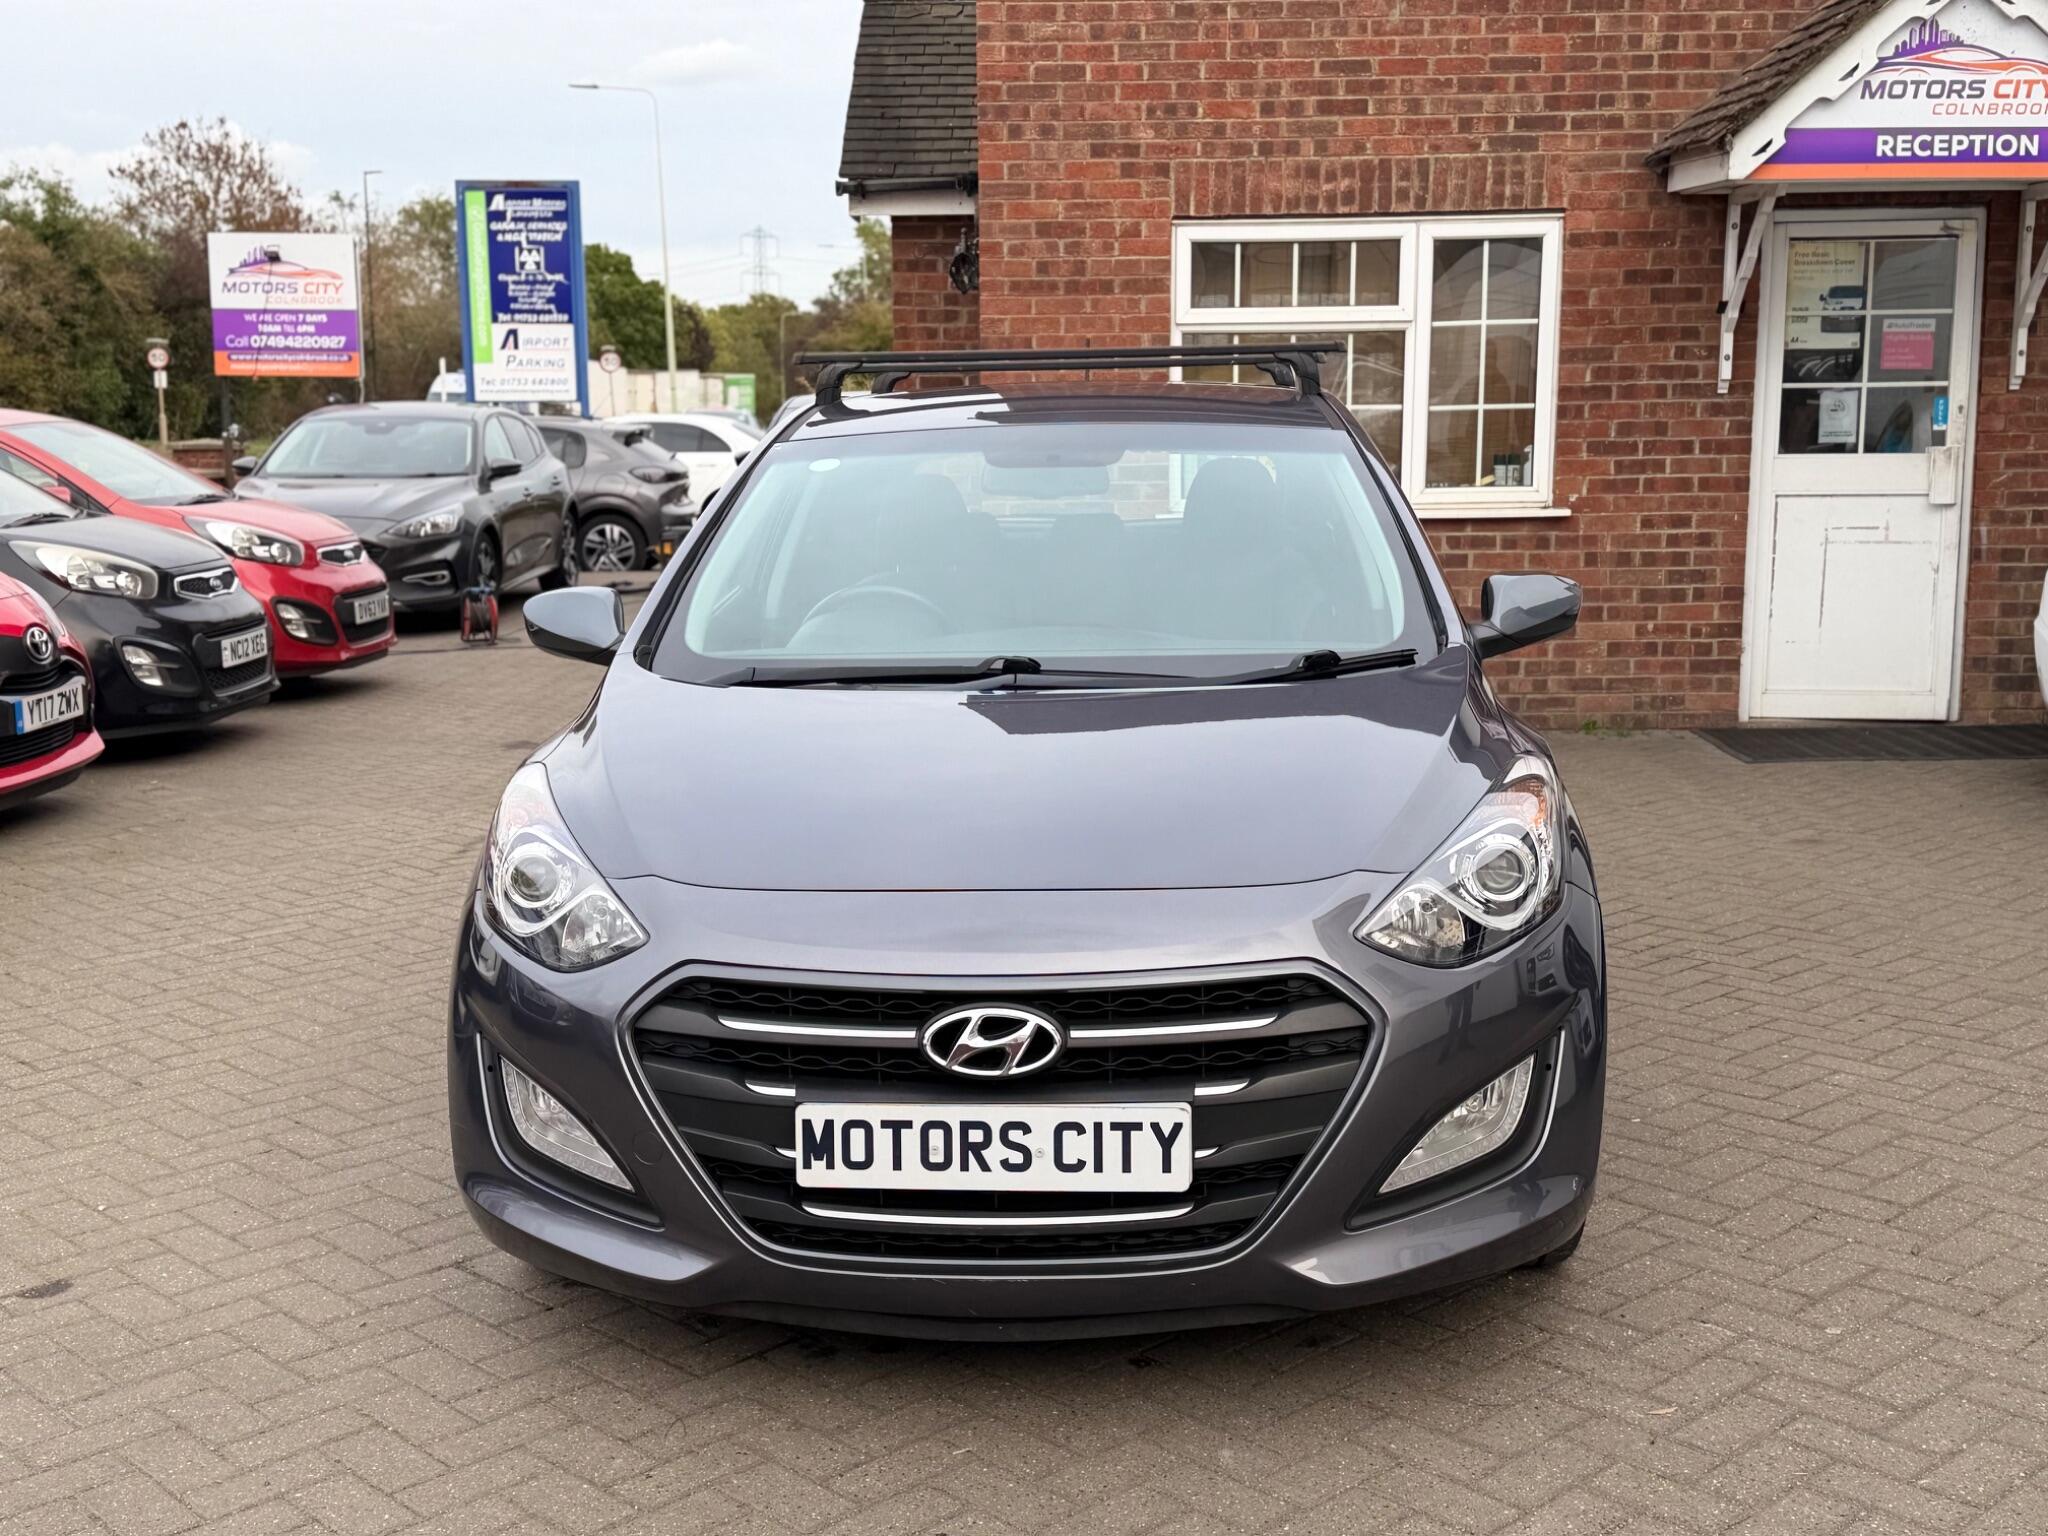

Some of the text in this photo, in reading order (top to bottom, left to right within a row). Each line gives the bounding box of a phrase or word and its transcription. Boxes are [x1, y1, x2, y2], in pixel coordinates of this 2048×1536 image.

[1860, 79, 1987, 99] MOTORS
[1932, 103, 2048, 115] COLNBROO
[1876, 134, 2039, 157] RECEPTION
[222, 281, 344, 295] MOTORS CITY
[243, 313, 257, 322] WE
[274, 313, 297, 322] OPEN
[305, 313, 328, 323] DAYS
[225, 334, 249, 348] Call
[501, 328, 570, 351] AIRPORT
[506, 354, 566, 369] PARKING
[230, 633, 265, 661] NC12 XEG
[27, 687, 80, 725] YT17 ZWX
[801, 1118, 1184, 1174] MOTORS CITY
